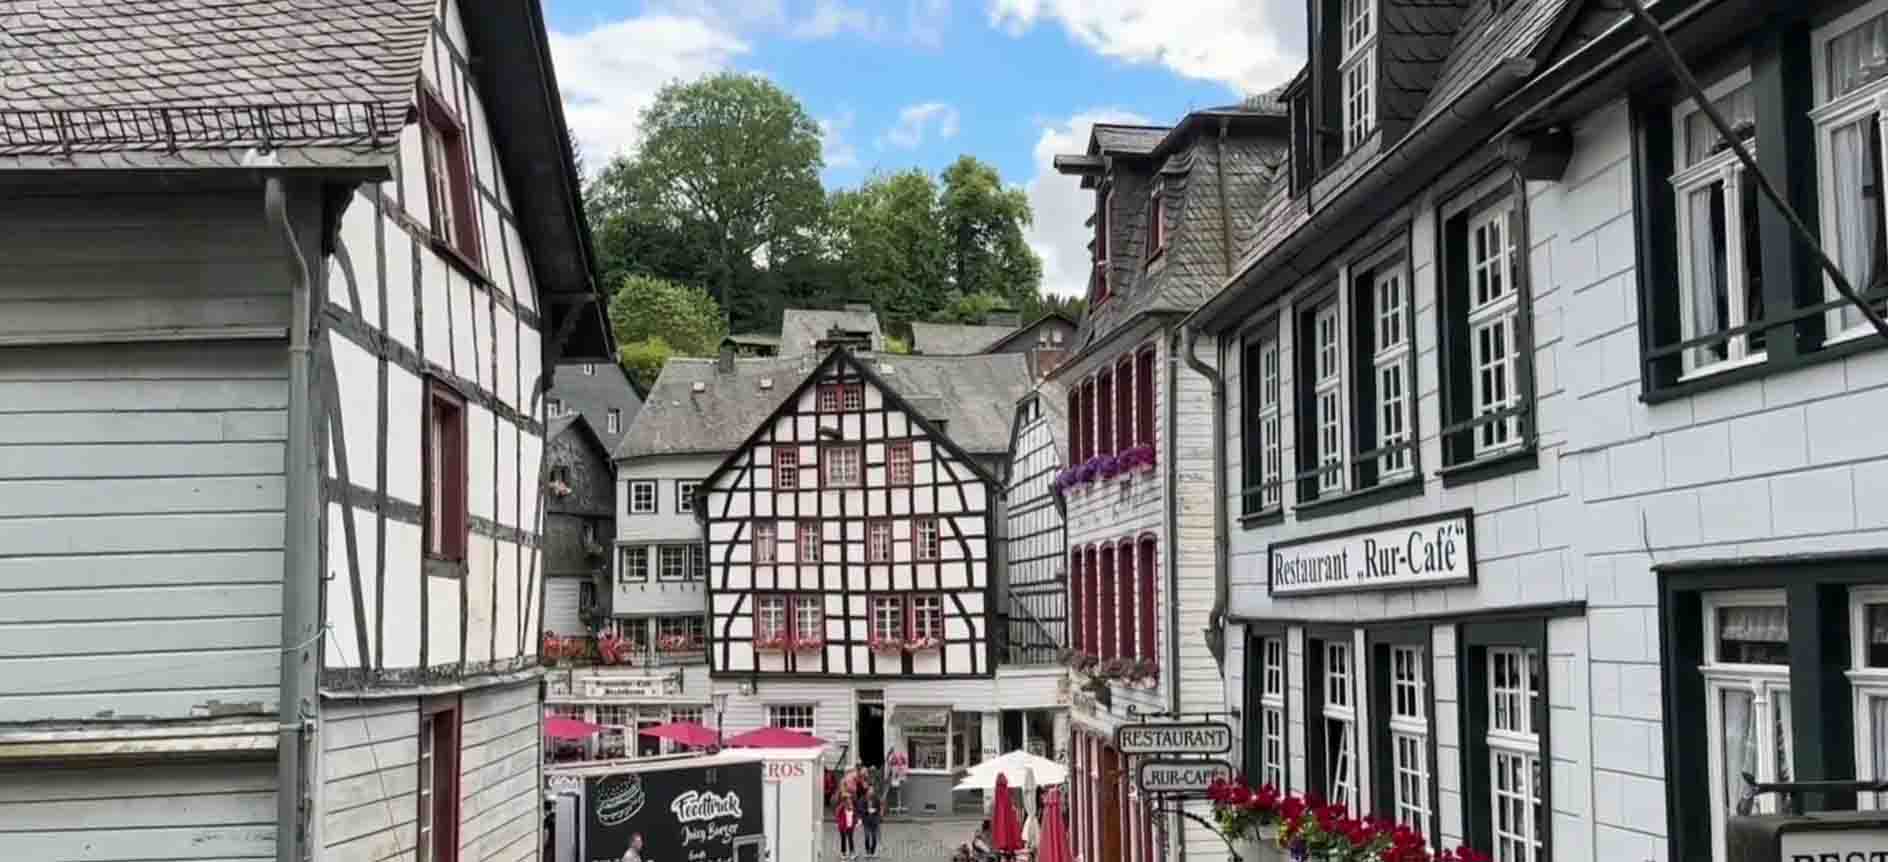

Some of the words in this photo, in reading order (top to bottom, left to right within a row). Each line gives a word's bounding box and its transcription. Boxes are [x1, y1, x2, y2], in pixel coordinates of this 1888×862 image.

[1274, 549, 1349, 586] Restaurant
[1122, 730, 1226, 746] RESTAURANT
[762, 761, 805, 778] ROS
[708, 821, 739, 845] Burger
